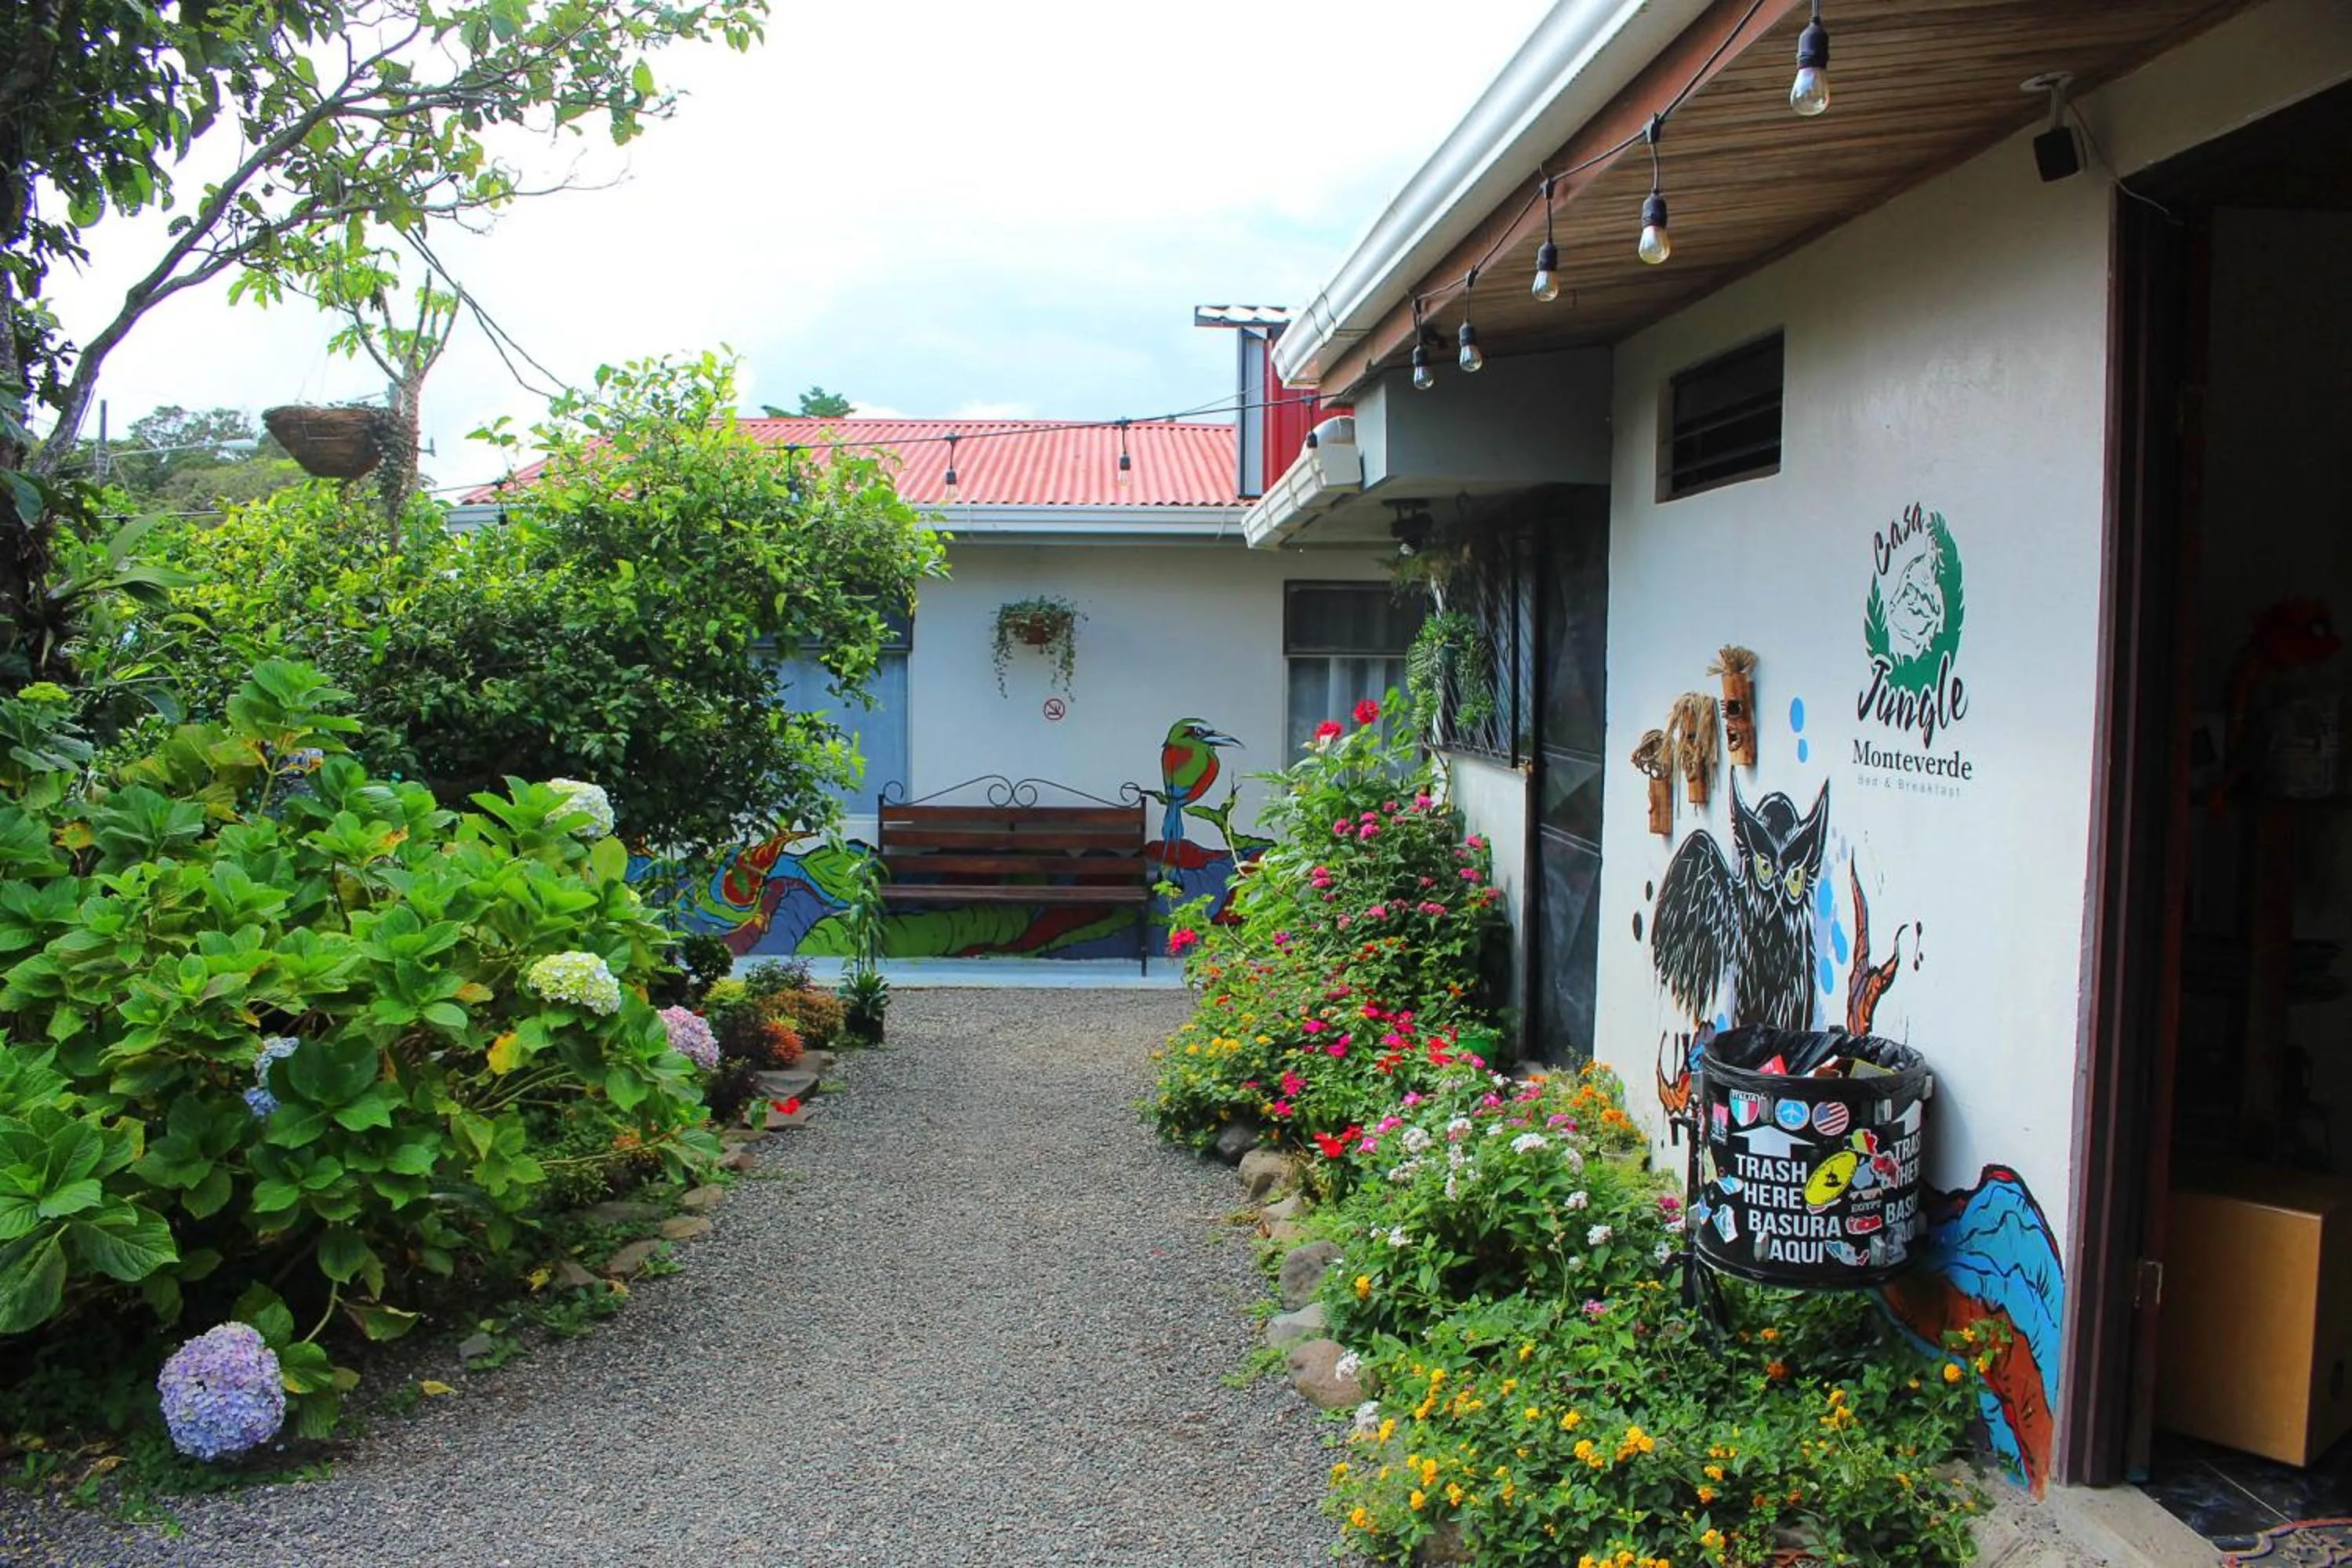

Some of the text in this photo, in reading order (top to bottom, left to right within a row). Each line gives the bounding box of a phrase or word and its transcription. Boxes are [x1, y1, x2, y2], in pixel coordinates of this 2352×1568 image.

[1874, 502, 1924, 575] Casa
[1858, 655, 1968, 749] Jungle
[1853, 739, 1973, 780] Monteverde
[1898, 779, 1961, 798] Breakfast
[1892, 1131, 1921, 1161] TRAS
[1734, 1153, 1807, 1183] TRASH
[1744, 1181, 1802, 1210] HERE
[1748, 1209, 1842, 1238] BASURA
[1769, 1239, 1824, 1264] AQUI
